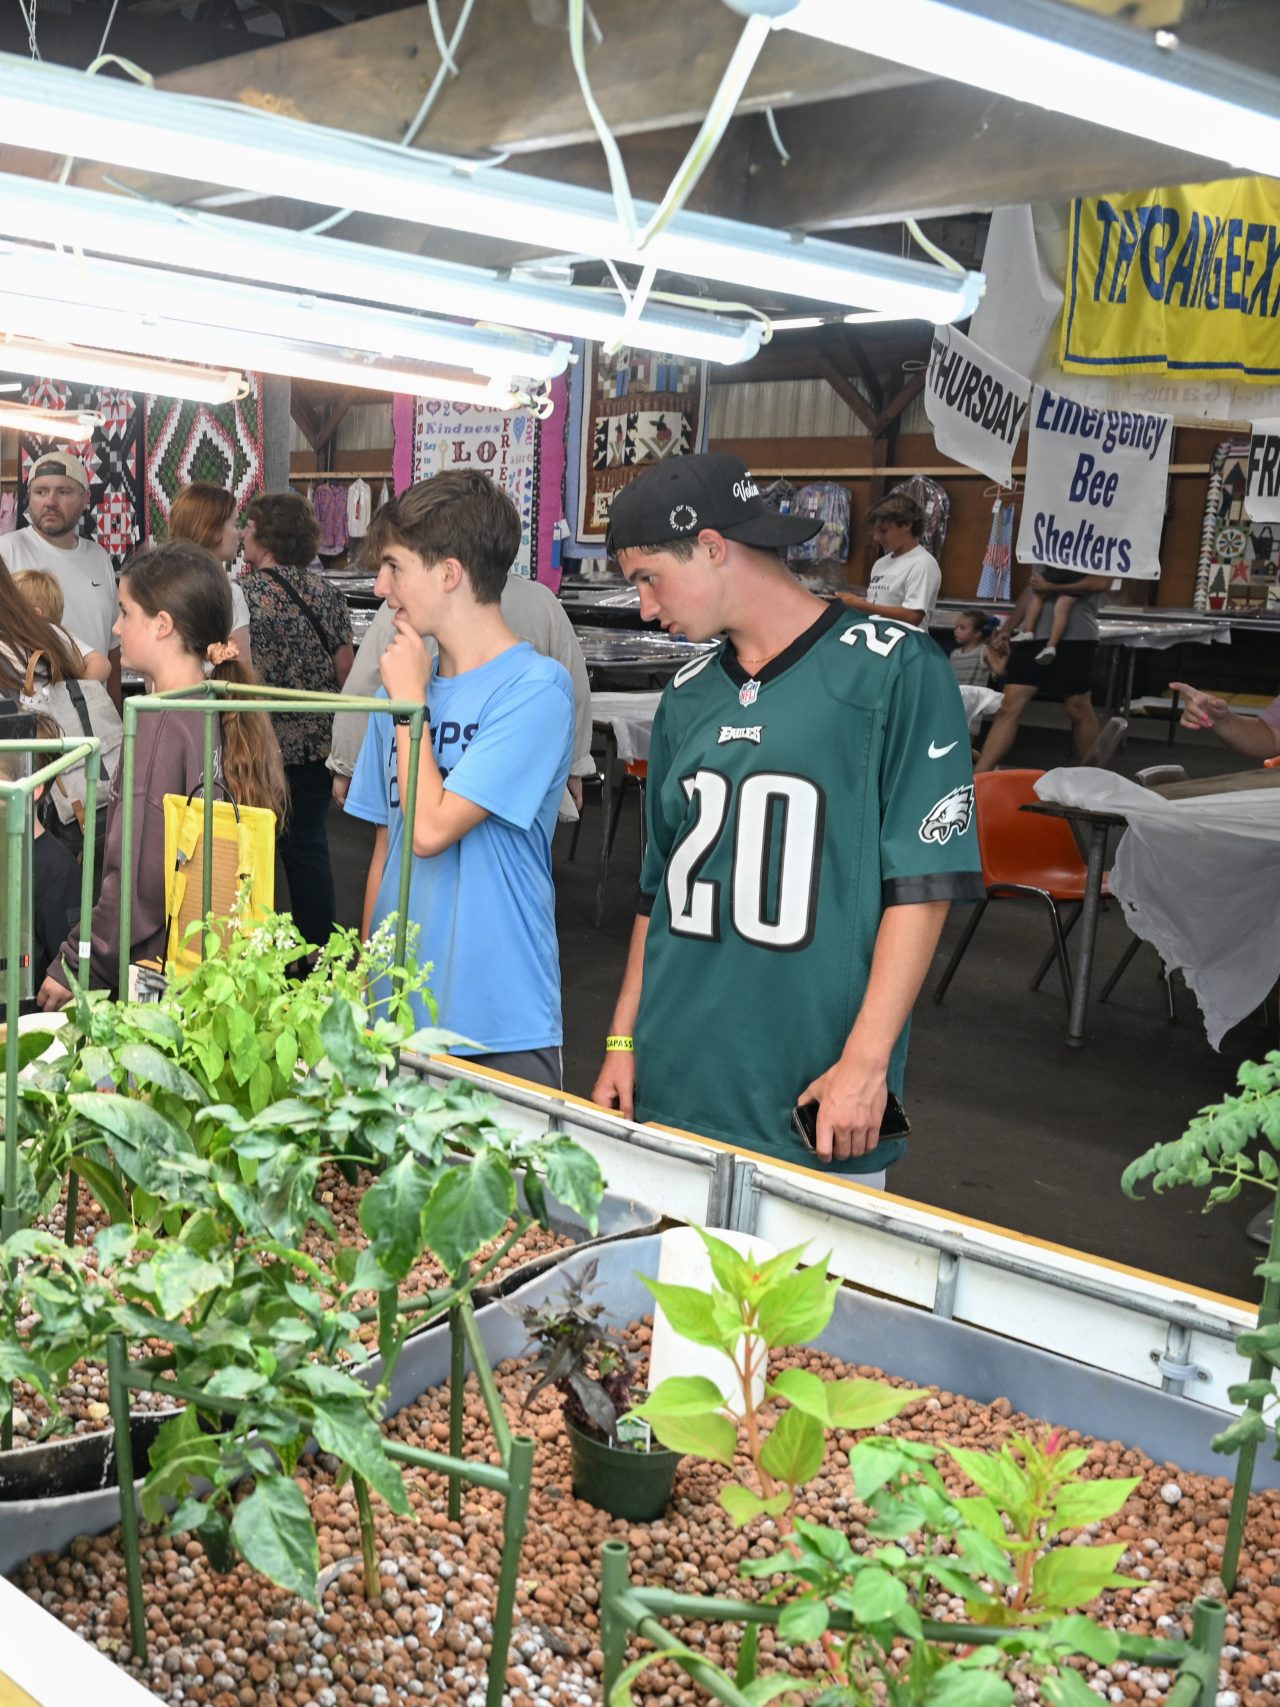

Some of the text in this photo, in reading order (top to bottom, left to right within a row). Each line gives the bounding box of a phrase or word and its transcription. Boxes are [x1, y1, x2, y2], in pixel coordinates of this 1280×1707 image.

[928, 338, 1028, 445] THURSDAY
[423, 441, 437, 451] Key
[425, 421, 501, 435] Kindness
[1035, 389, 1168, 461] Emergency
[1068, 452, 1119, 508] Bee
[1031, 512, 1132, 573] Shelters
[740, 690, 756, 702] NFL
[717, 725, 764, 745] EAGLES
[665, 767, 826, 953] 20
